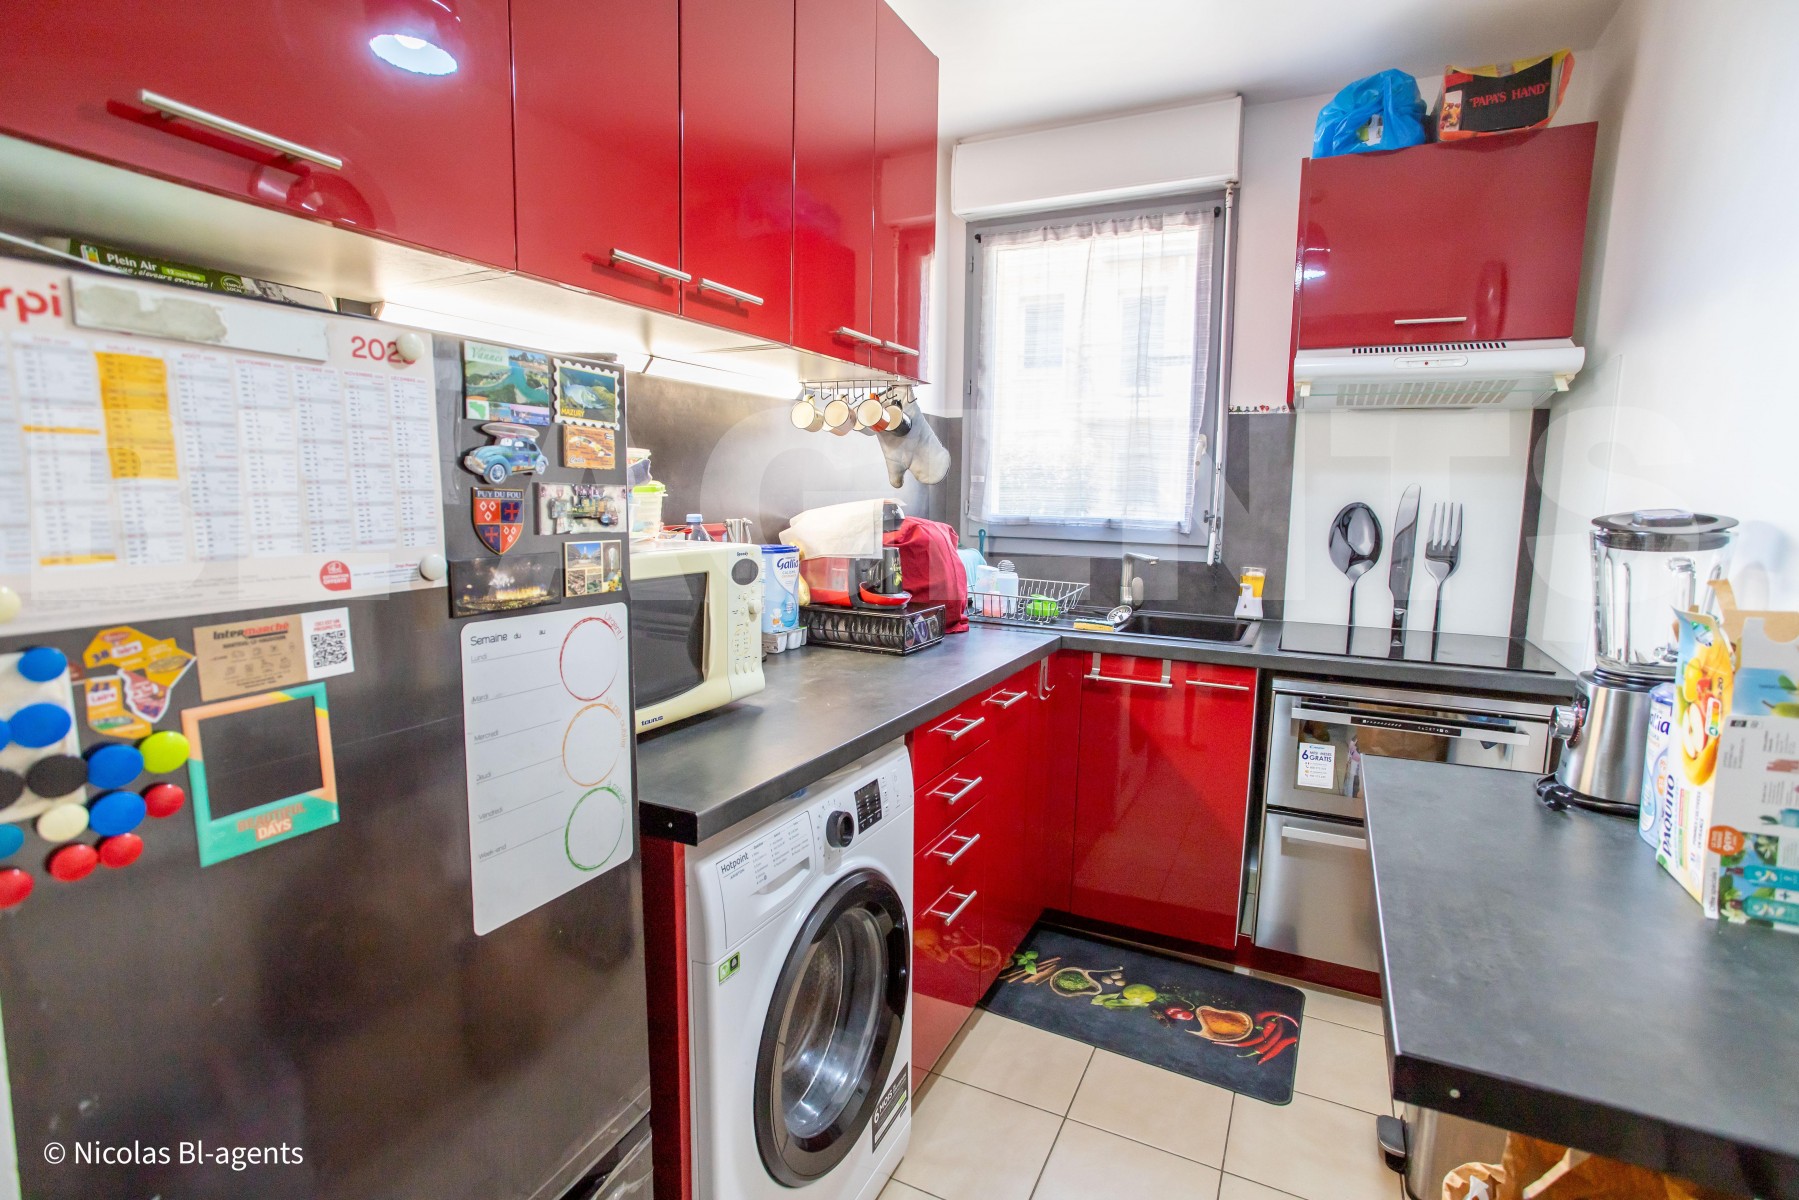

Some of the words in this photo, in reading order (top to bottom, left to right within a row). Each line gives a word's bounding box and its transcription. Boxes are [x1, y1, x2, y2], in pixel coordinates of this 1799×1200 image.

[106, 252, 137, 268] Plein
[140, 259, 157, 272] Air
[351, 335, 417, 365] 202
[560, 407, 585, 418] MAZURY
[477, 490, 493, 499] PUY
[494, 490, 506, 499] DU
[507, 491, 522, 499] FOU
[776, 557, 799, 570] Gallia
[213, 622, 290, 640] Intermarché
[470, 633, 508, 647] Semaine
[470, 653, 488, 663] Lundi
[471, 693, 490, 703] Mardi
[641, 715, 664, 726] taurus
[474, 729, 499, 742] Mercredi
[1302, 749, 1309, 760] 6
[1309, 755, 1333, 763] GRATIS
[236, 802, 306, 832] BEAUTIFUL
[478, 806, 504, 820] Vendredi
[1662, 774, 1675, 857] PAQUITO
[257, 818, 293, 841] DAYS
[720, 852, 749, 874] Hotpoint
[873, 1108, 880, 1124] 6
[879, 1089, 893, 1113] MOIS
